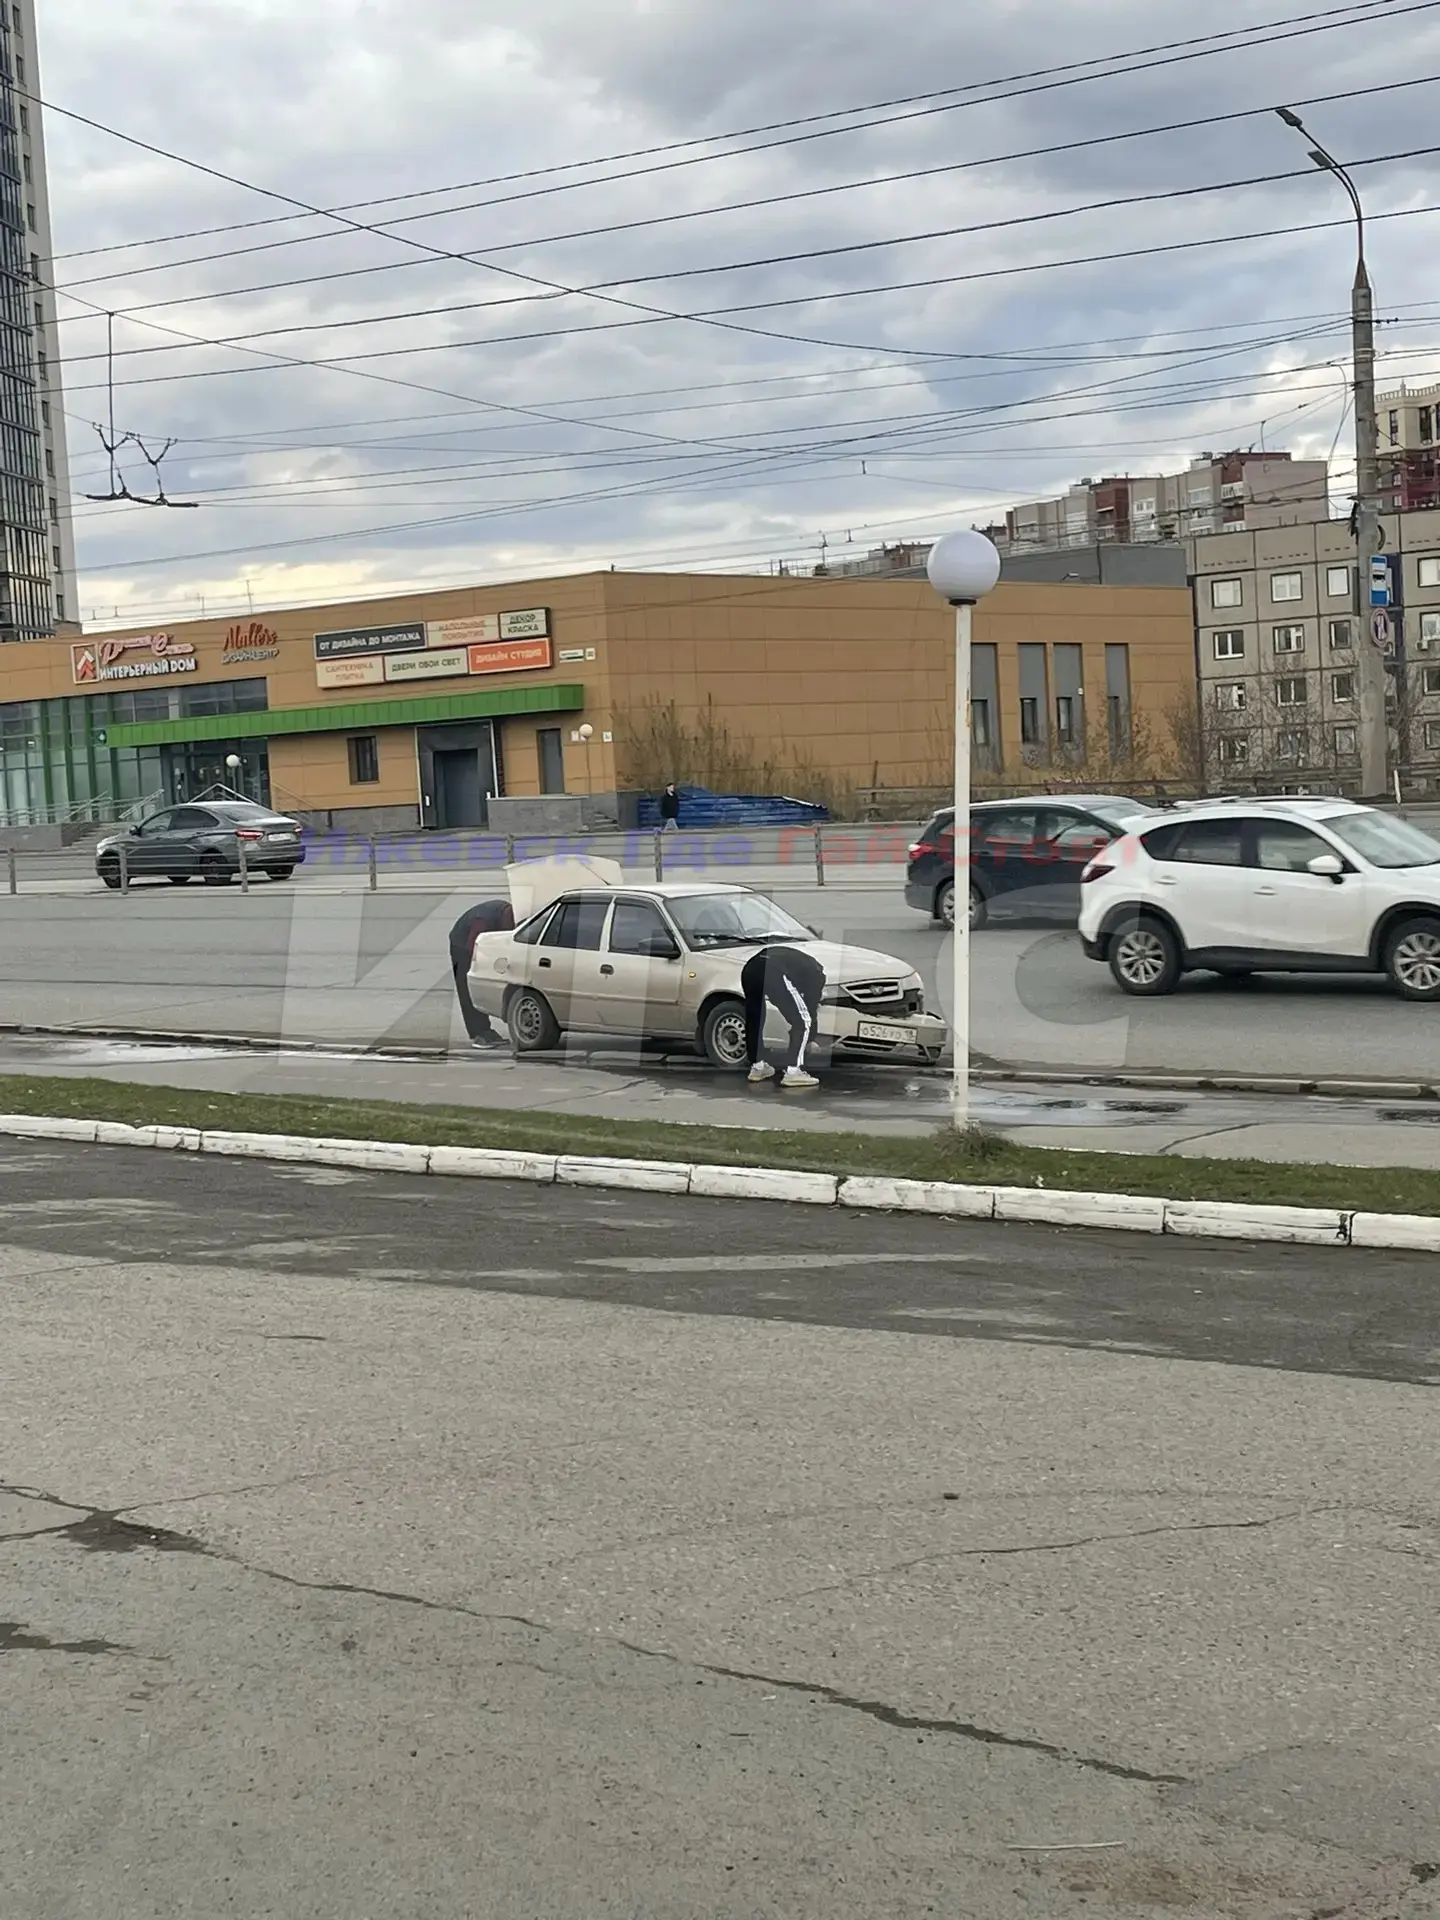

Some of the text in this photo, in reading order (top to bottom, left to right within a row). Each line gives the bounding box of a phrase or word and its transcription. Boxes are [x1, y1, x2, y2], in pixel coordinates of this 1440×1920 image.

[507, 623, 539, 634] КРАСКА
[319, 631, 421, 651] ОТ ДИЗАЙНА ДО МОНТАЖА
[100, 658, 169, 681] ИНТЕРЬЕРНЫЙ
[391, 662, 416, 673] ДВЕРИ
[441, 657, 461, 667] СВЕТ
